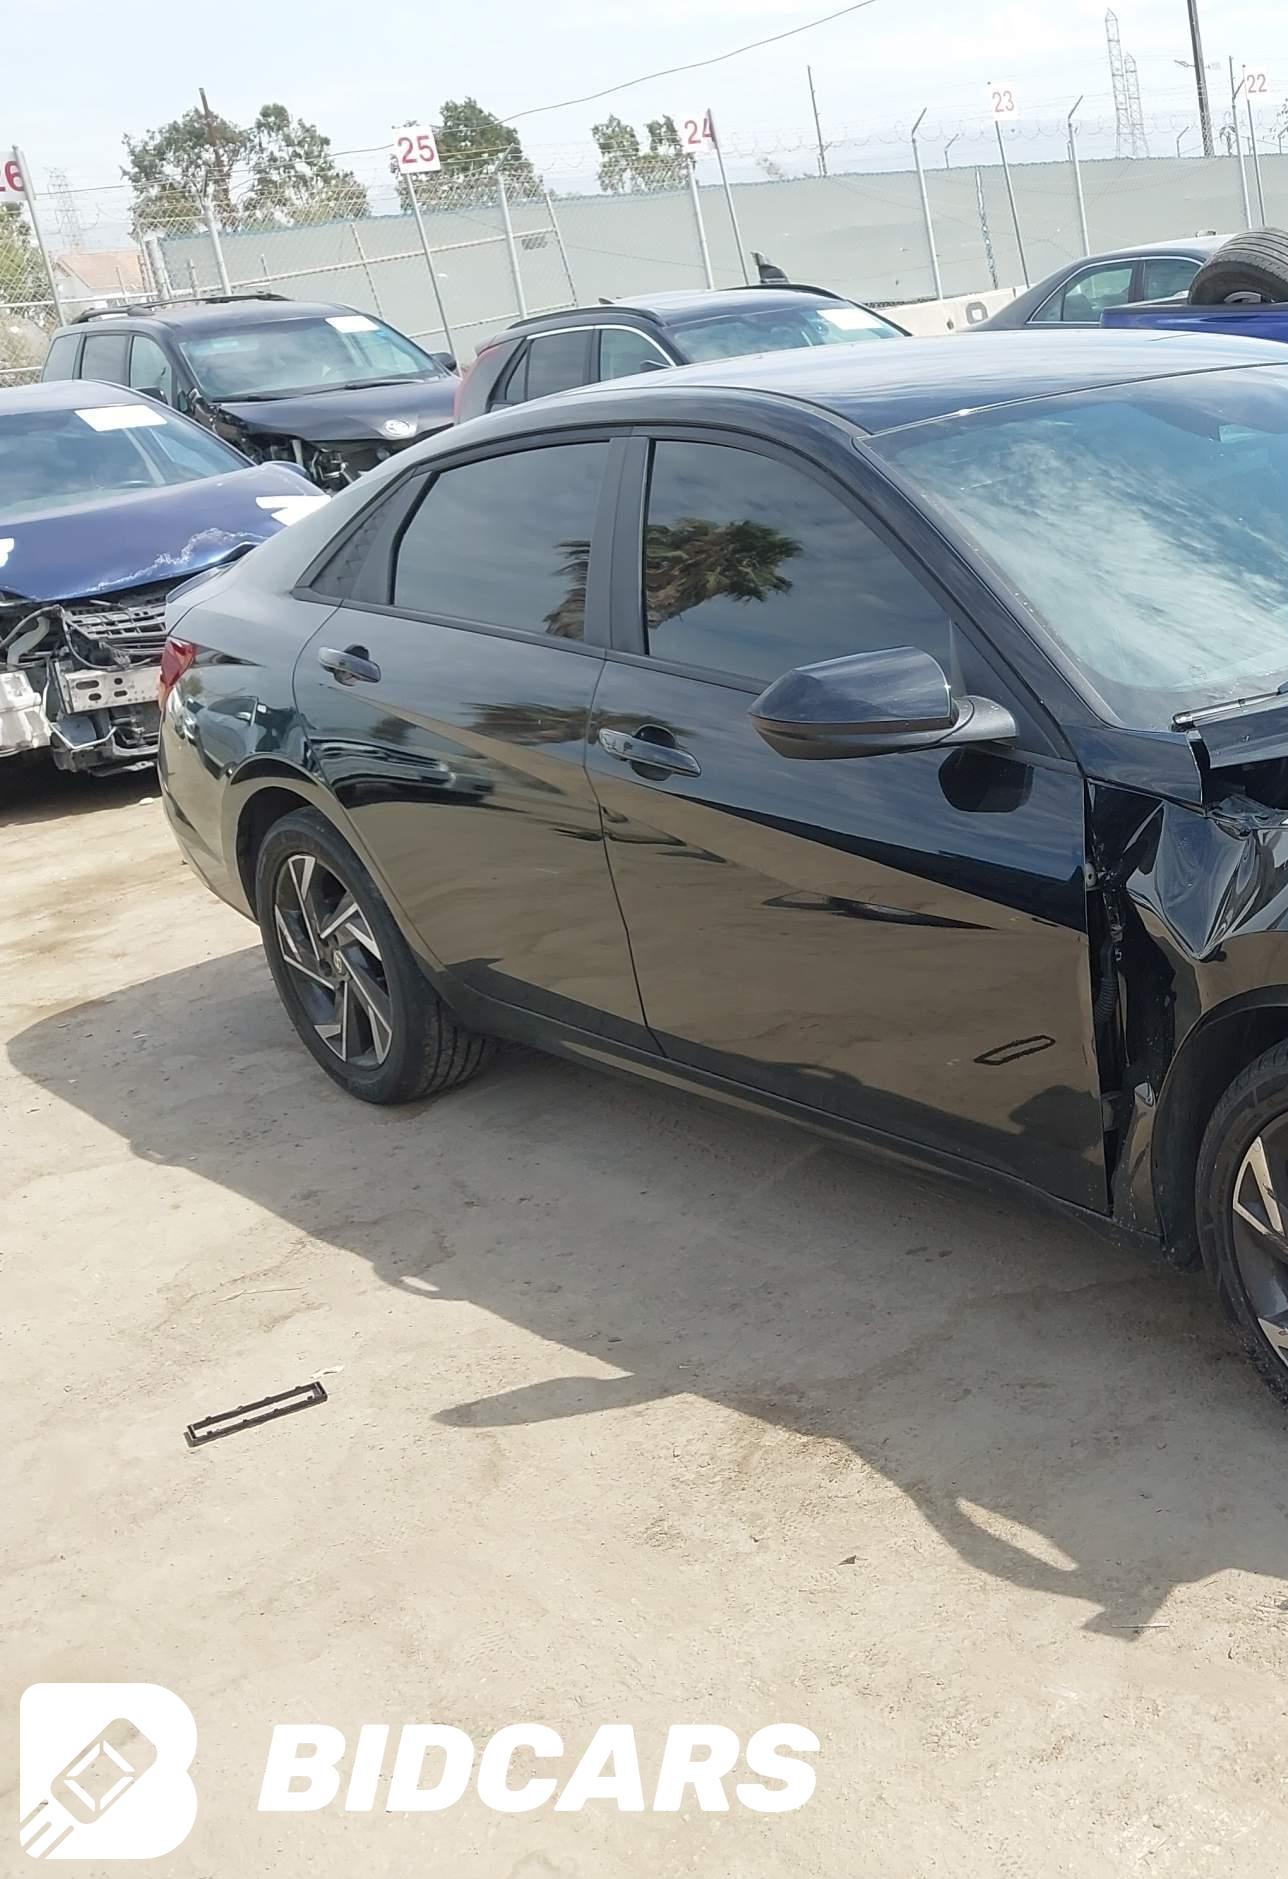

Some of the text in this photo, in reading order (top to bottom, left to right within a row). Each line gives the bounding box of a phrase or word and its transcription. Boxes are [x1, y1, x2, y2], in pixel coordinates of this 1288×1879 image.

[1246, 73, 1268, 93] 22
[992, 90, 1014, 112] 23
[684, 118, 715, 144] 24
[397, 135, 434, 164] 25
[0, 160, 24, 192] 6
